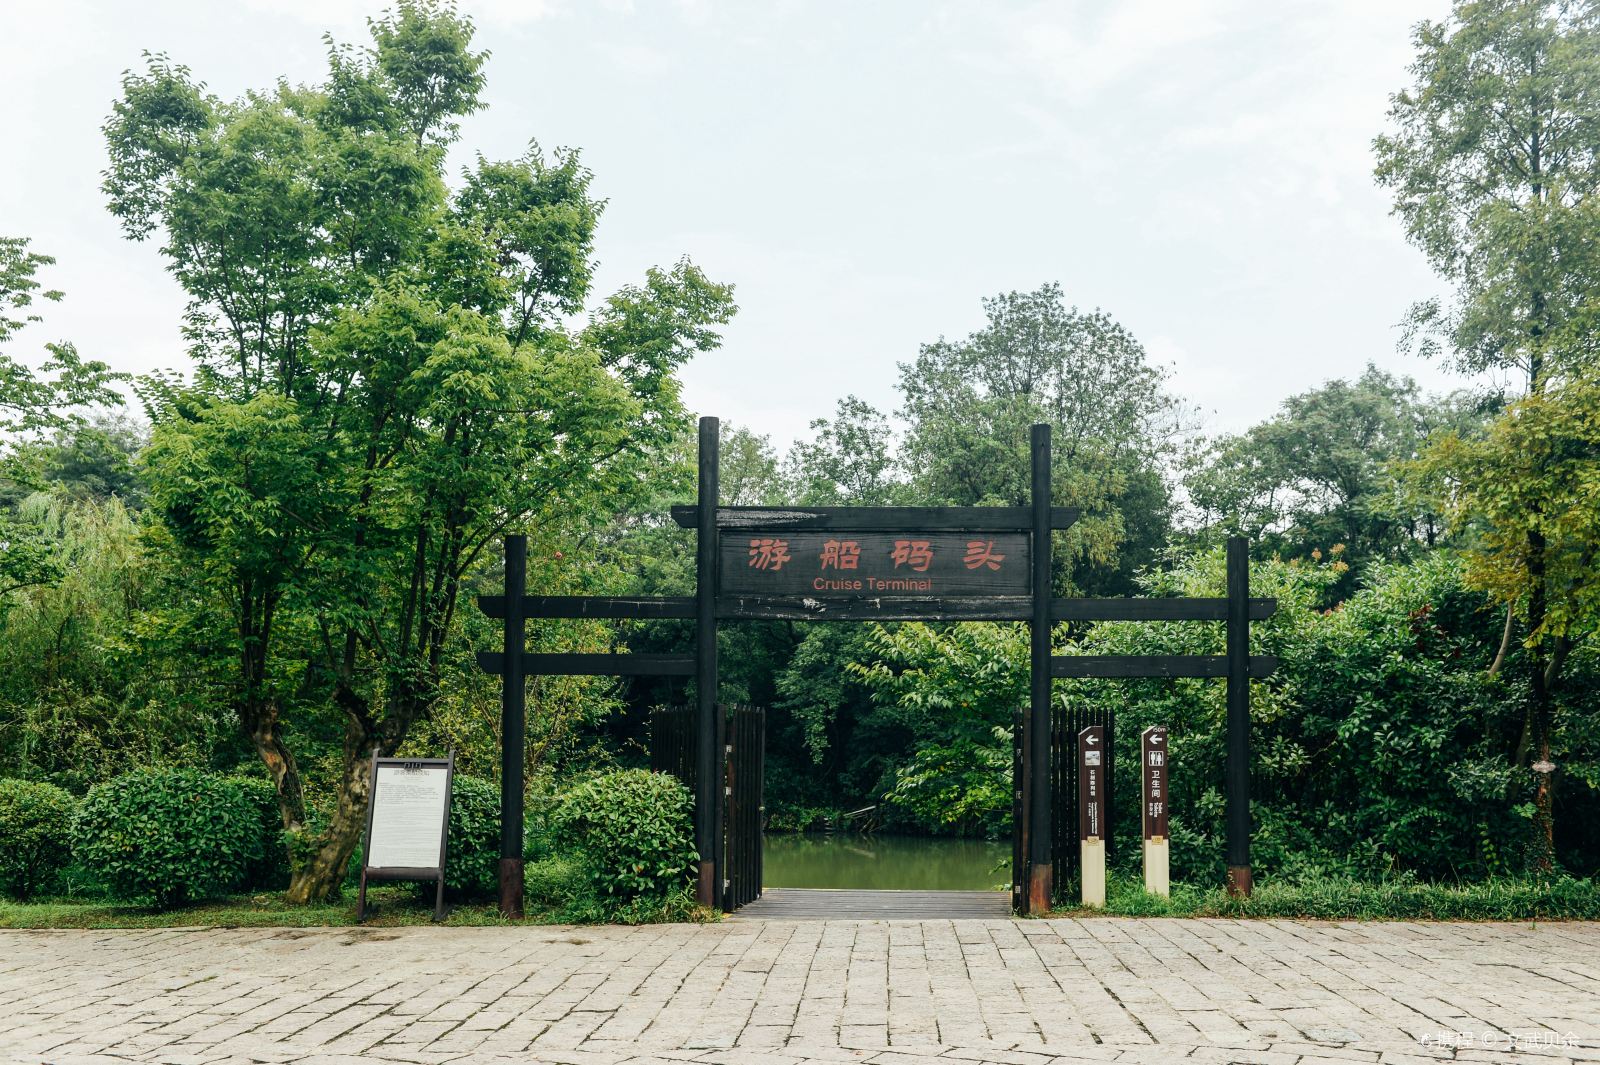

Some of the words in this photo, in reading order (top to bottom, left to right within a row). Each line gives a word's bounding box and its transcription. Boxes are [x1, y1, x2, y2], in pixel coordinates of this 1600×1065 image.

[748, 538, 1006, 572] 游船码头
[813, 577, 862, 591] Cruise
[866, 577, 932, 591] Terminal
[1151, 770, 1160, 798] 卫生间
